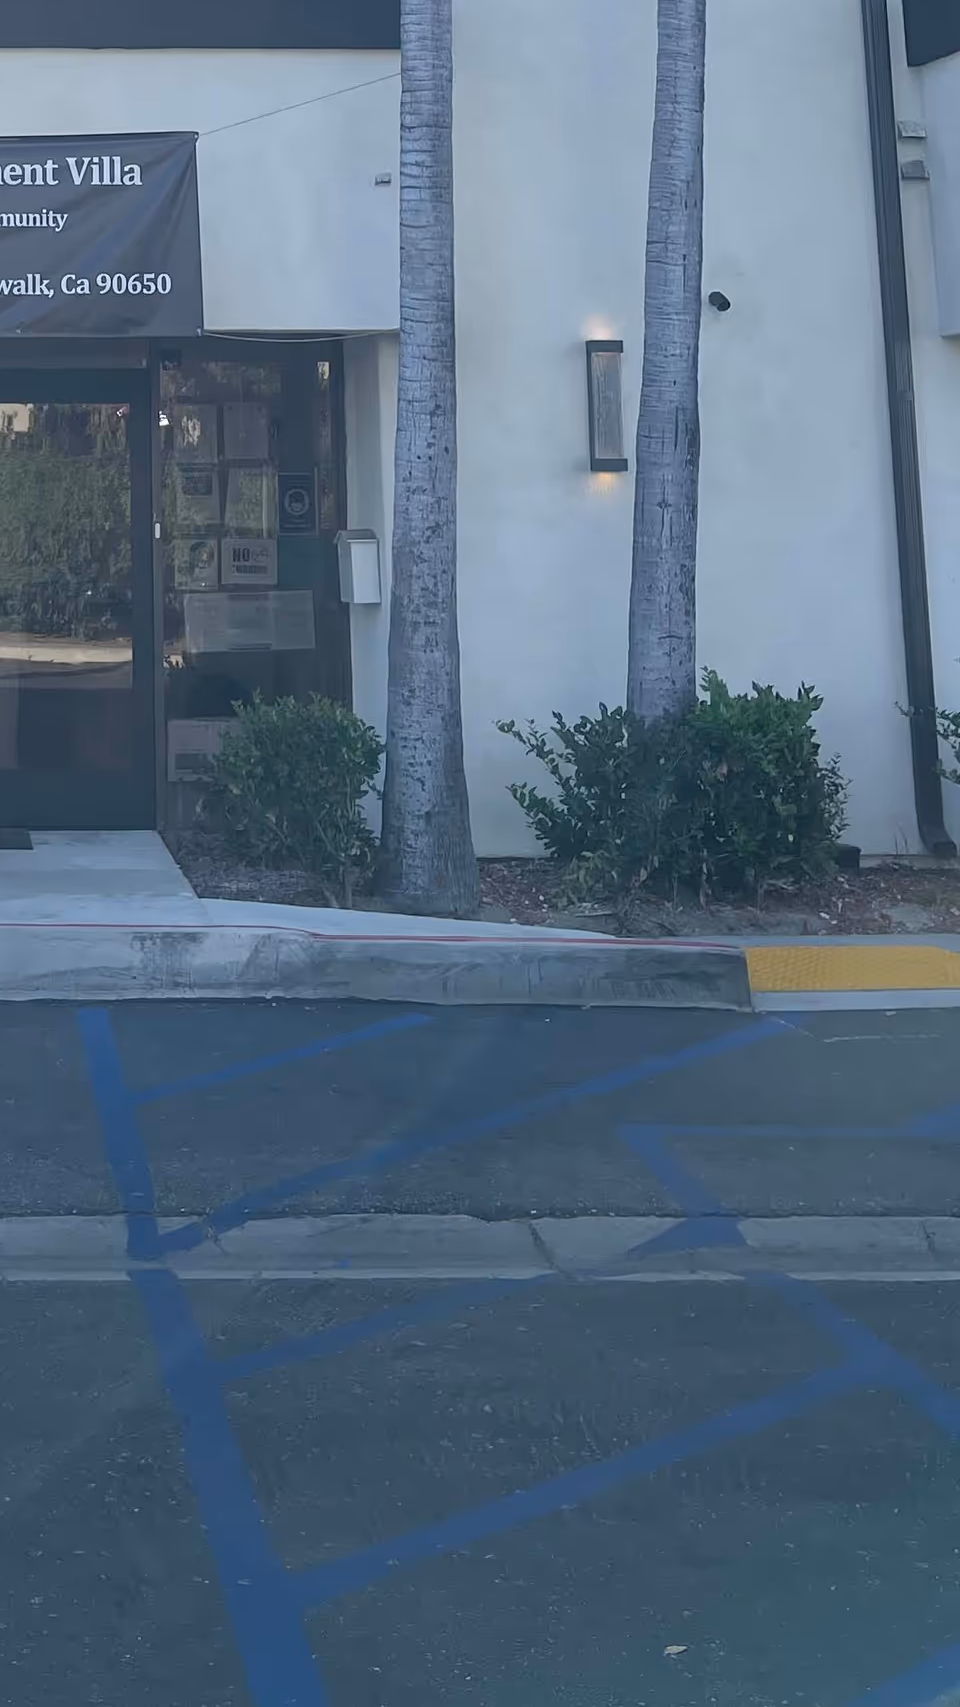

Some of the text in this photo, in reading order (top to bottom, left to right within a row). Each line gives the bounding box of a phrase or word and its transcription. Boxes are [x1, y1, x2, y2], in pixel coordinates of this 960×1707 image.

[65, 155, 143, 186] Villa
[60, 274, 91, 295] Ca
[96, 272, 172, 295] 90650
